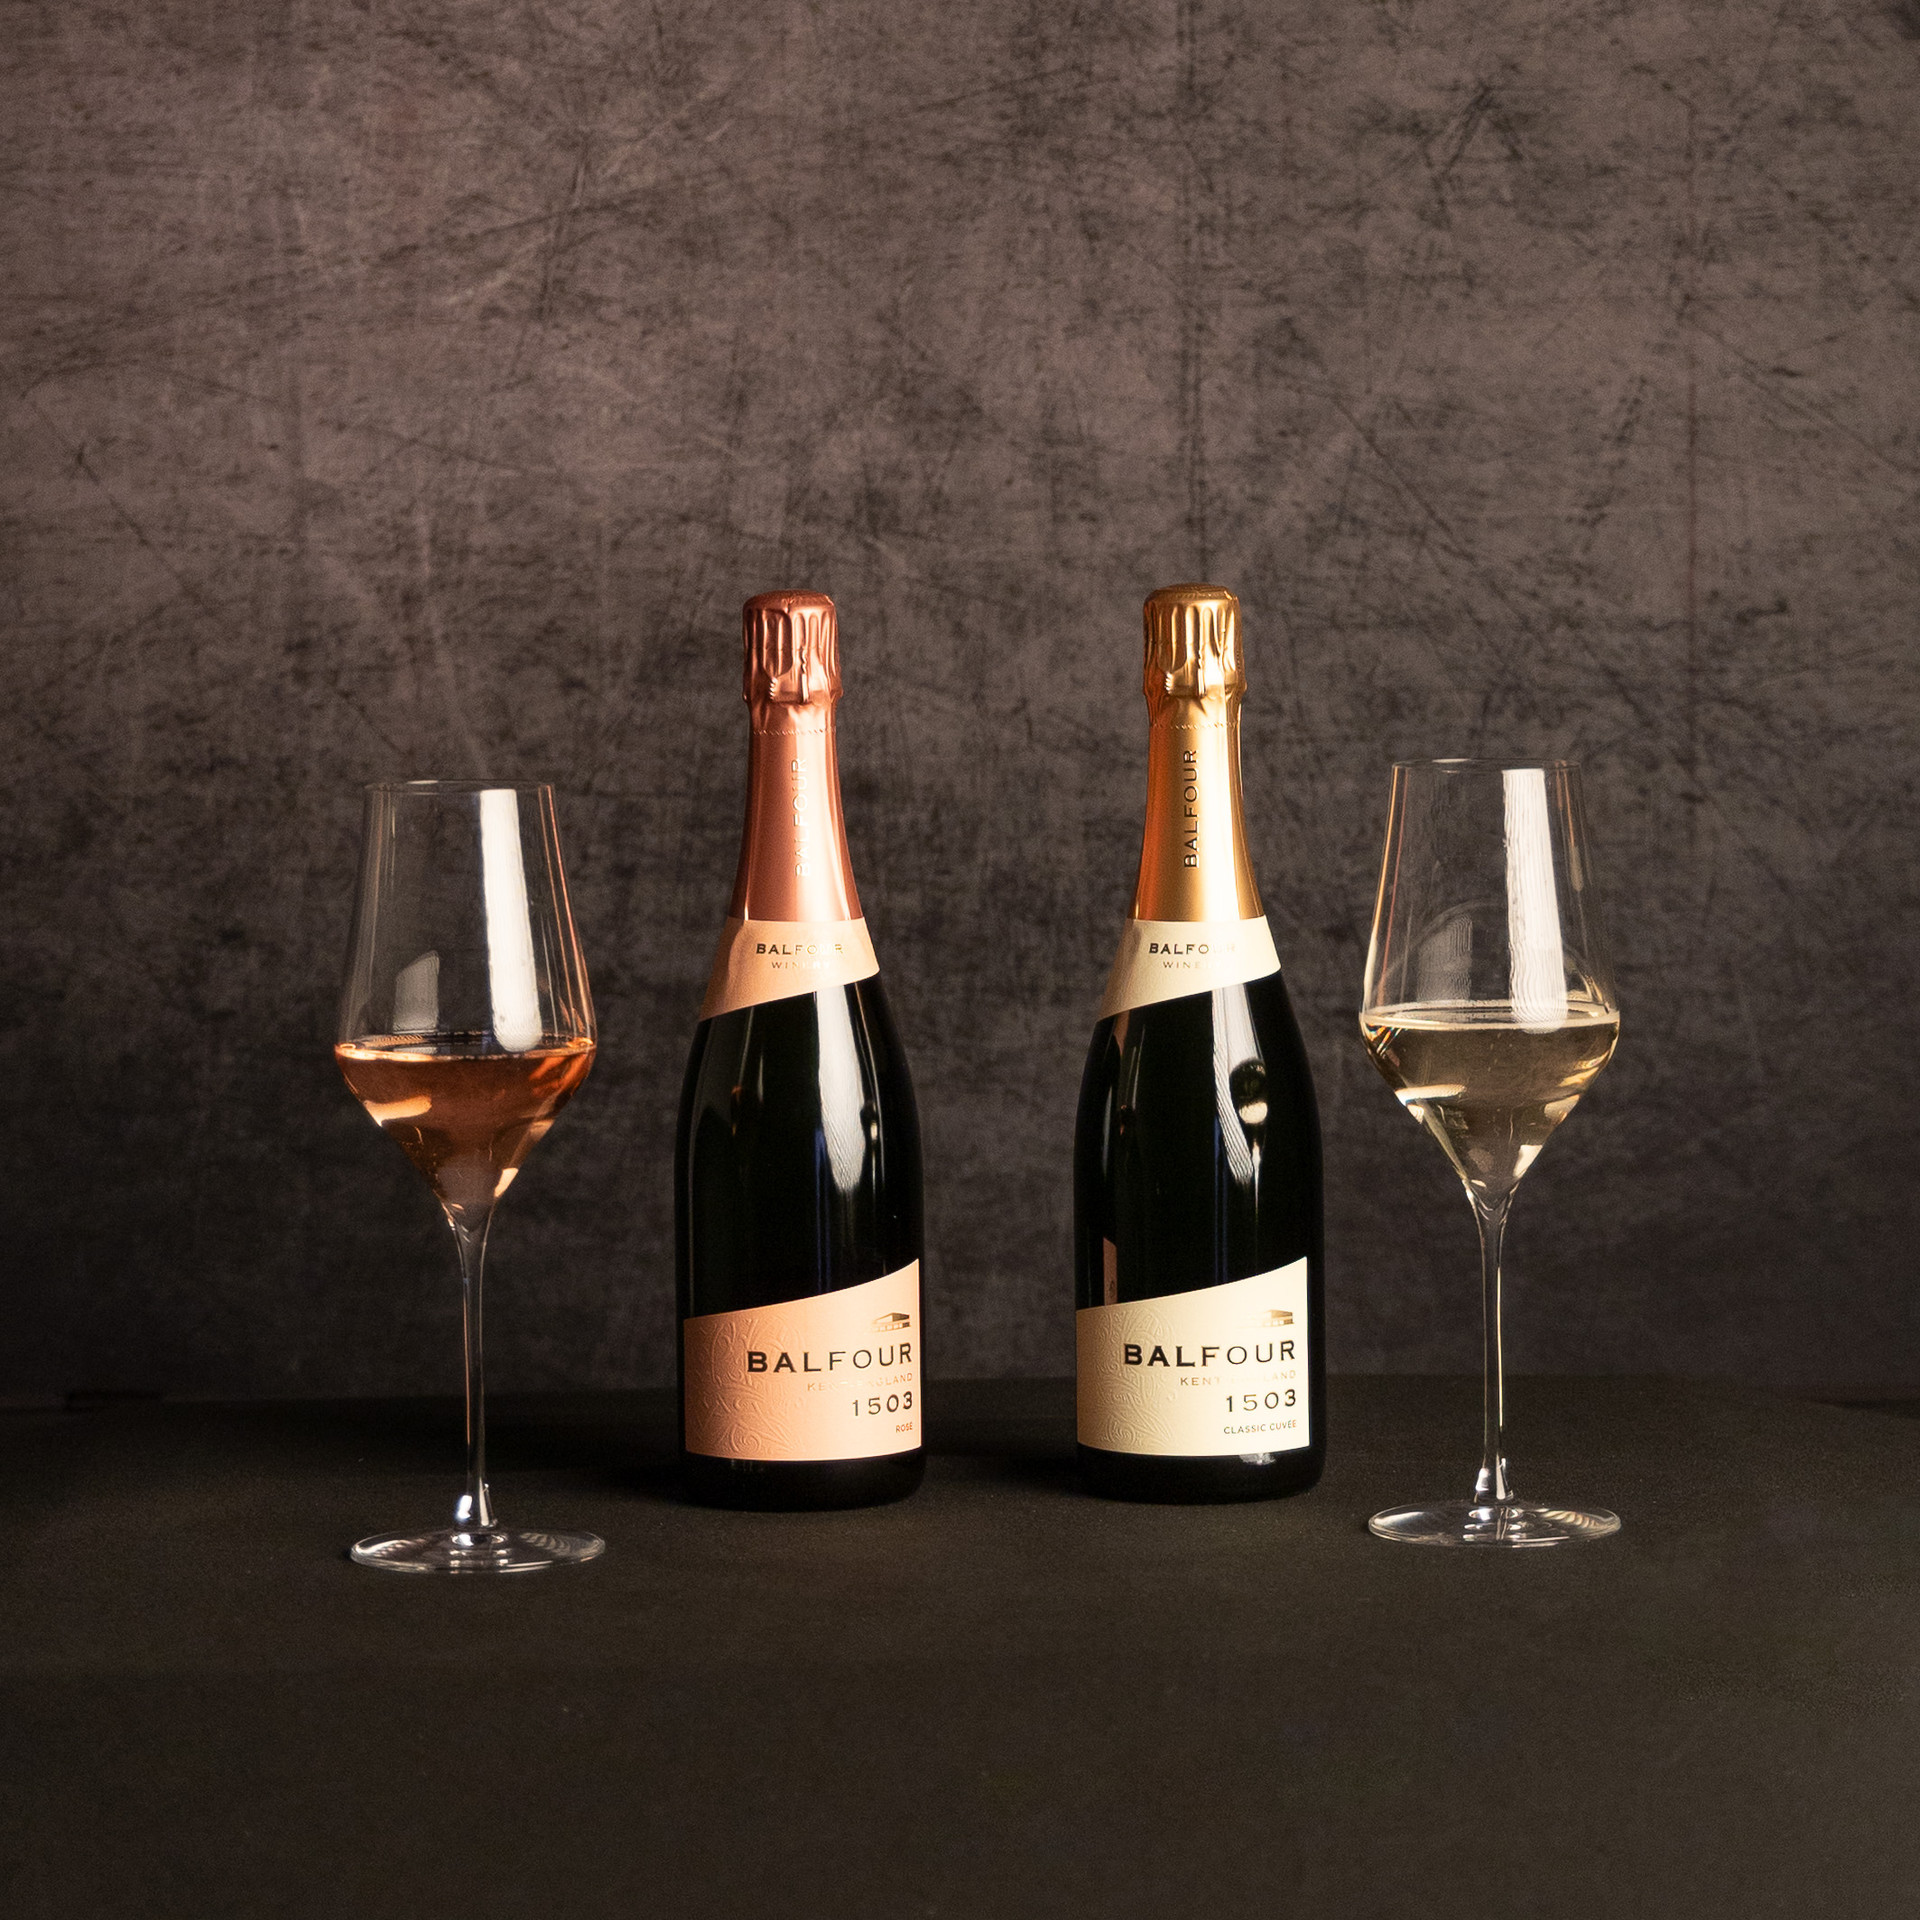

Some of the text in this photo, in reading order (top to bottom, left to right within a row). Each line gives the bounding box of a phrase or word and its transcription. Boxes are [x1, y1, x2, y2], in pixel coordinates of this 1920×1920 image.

[1183, 749, 1199, 869] BALFOUR
[755, 942, 845, 956] BALFOR
[746, 1341, 913, 1373] BALFOUR
[1122, 1339, 1296, 1368] BALFOUR
[851, 1390, 914, 1417] 1503
[1225, 1388, 1297, 1413] 1503
[1223, 1423, 1267, 1435] CLASSIC
